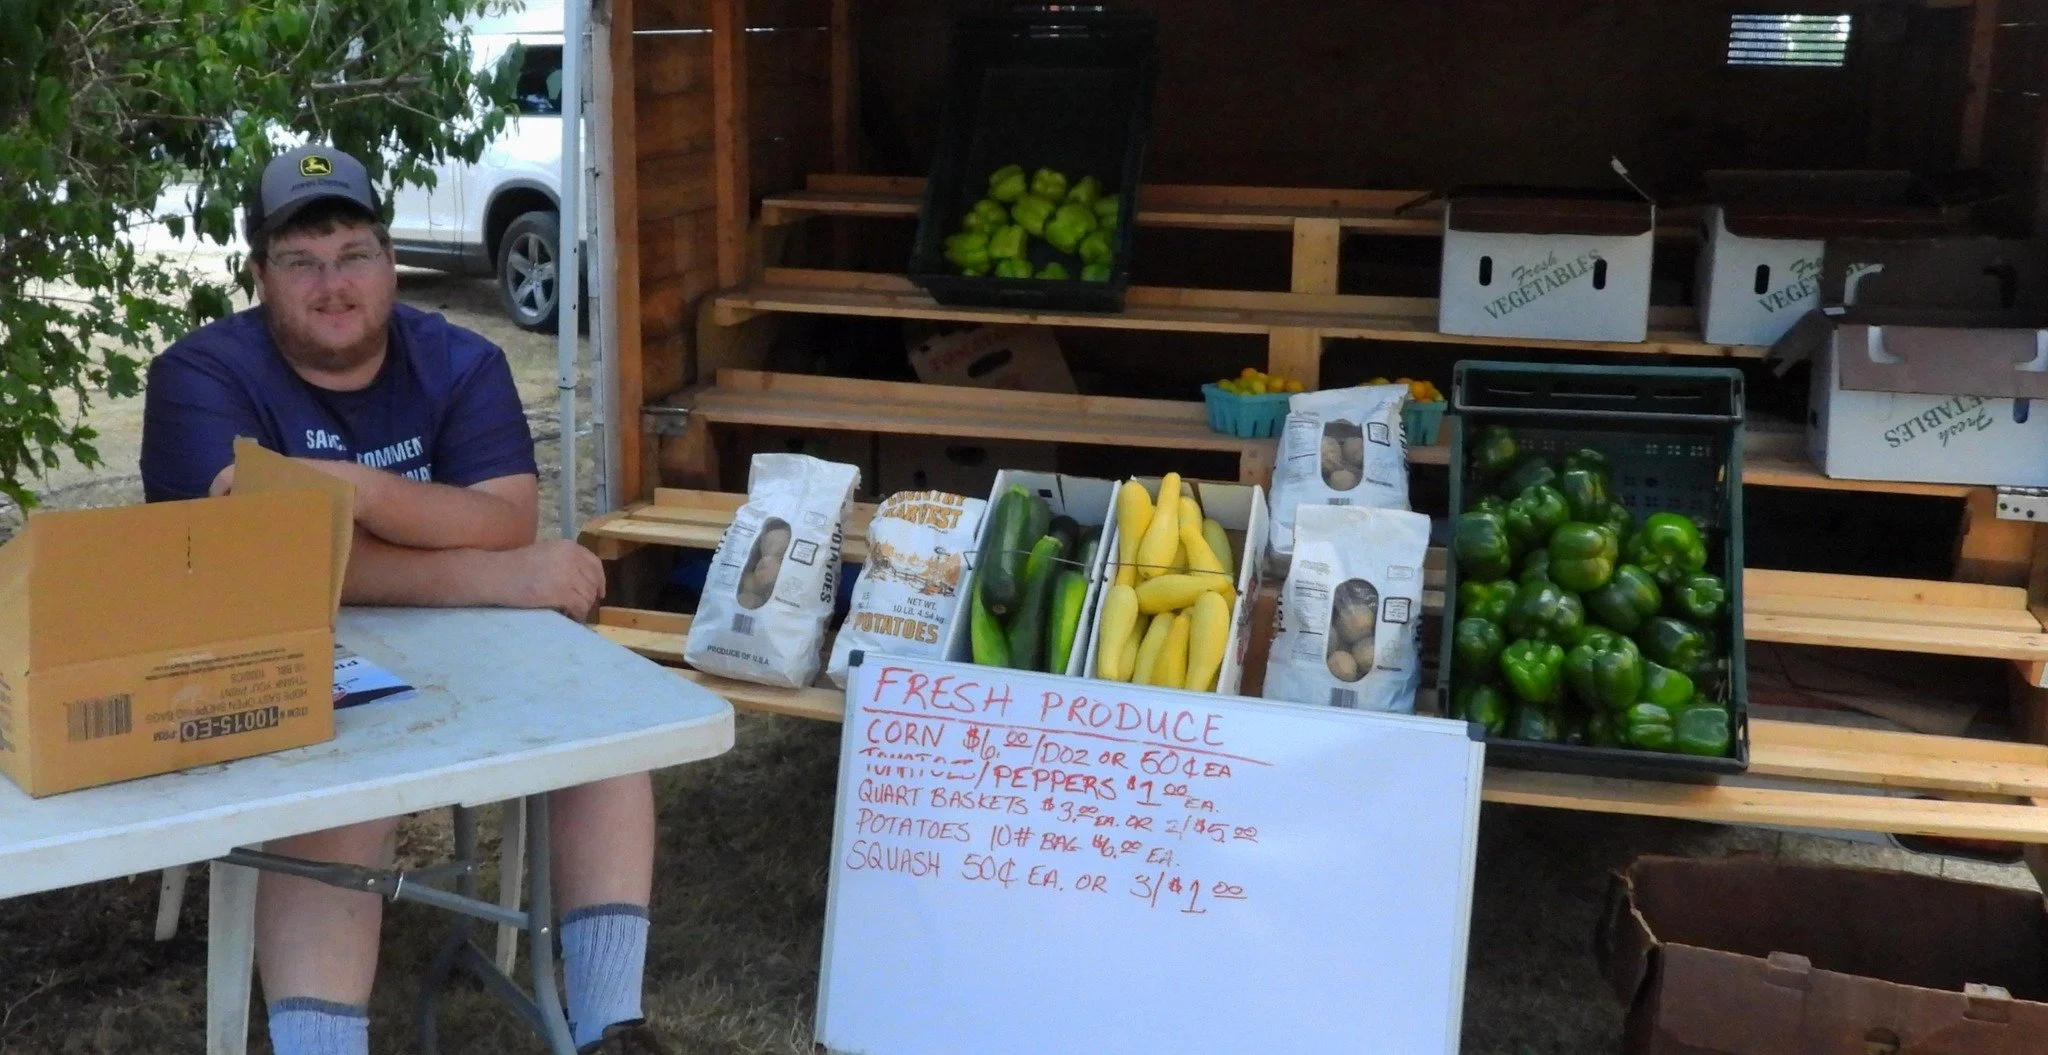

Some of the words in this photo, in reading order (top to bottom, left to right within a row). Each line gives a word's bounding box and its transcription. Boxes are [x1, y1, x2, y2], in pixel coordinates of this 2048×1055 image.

[1483, 249, 1601, 320] VEGETABLES
[1510, 249, 1558, 286] Fresh
[1938, 406, 1993, 448] Fresh
[907, 597, 923, 607] NET
[852, 611, 939, 645] POTATOES
[706, 644, 740, 659] PRODUCE
[180, 706, 279, 743] 10015-EO
[872, 667, 1013, 718] FRESH
[1040, 691, 1225, 747] PRODUCE
[866, 718, 945, 748] CORN
[1098, 751, 1129, 769] OR
[1203, 762, 1232, 778] EA
[858, 778, 924, 807] QUART
[930, 786, 1029, 816] BASKETS
[1125, 814, 1154, 832] OR
[856, 807, 971, 843] POTATOES
[1040, 832, 1083, 852] BAG
[845, 839, 941, 880] SQUASH
[1075, 874, 1107, 894] OR
